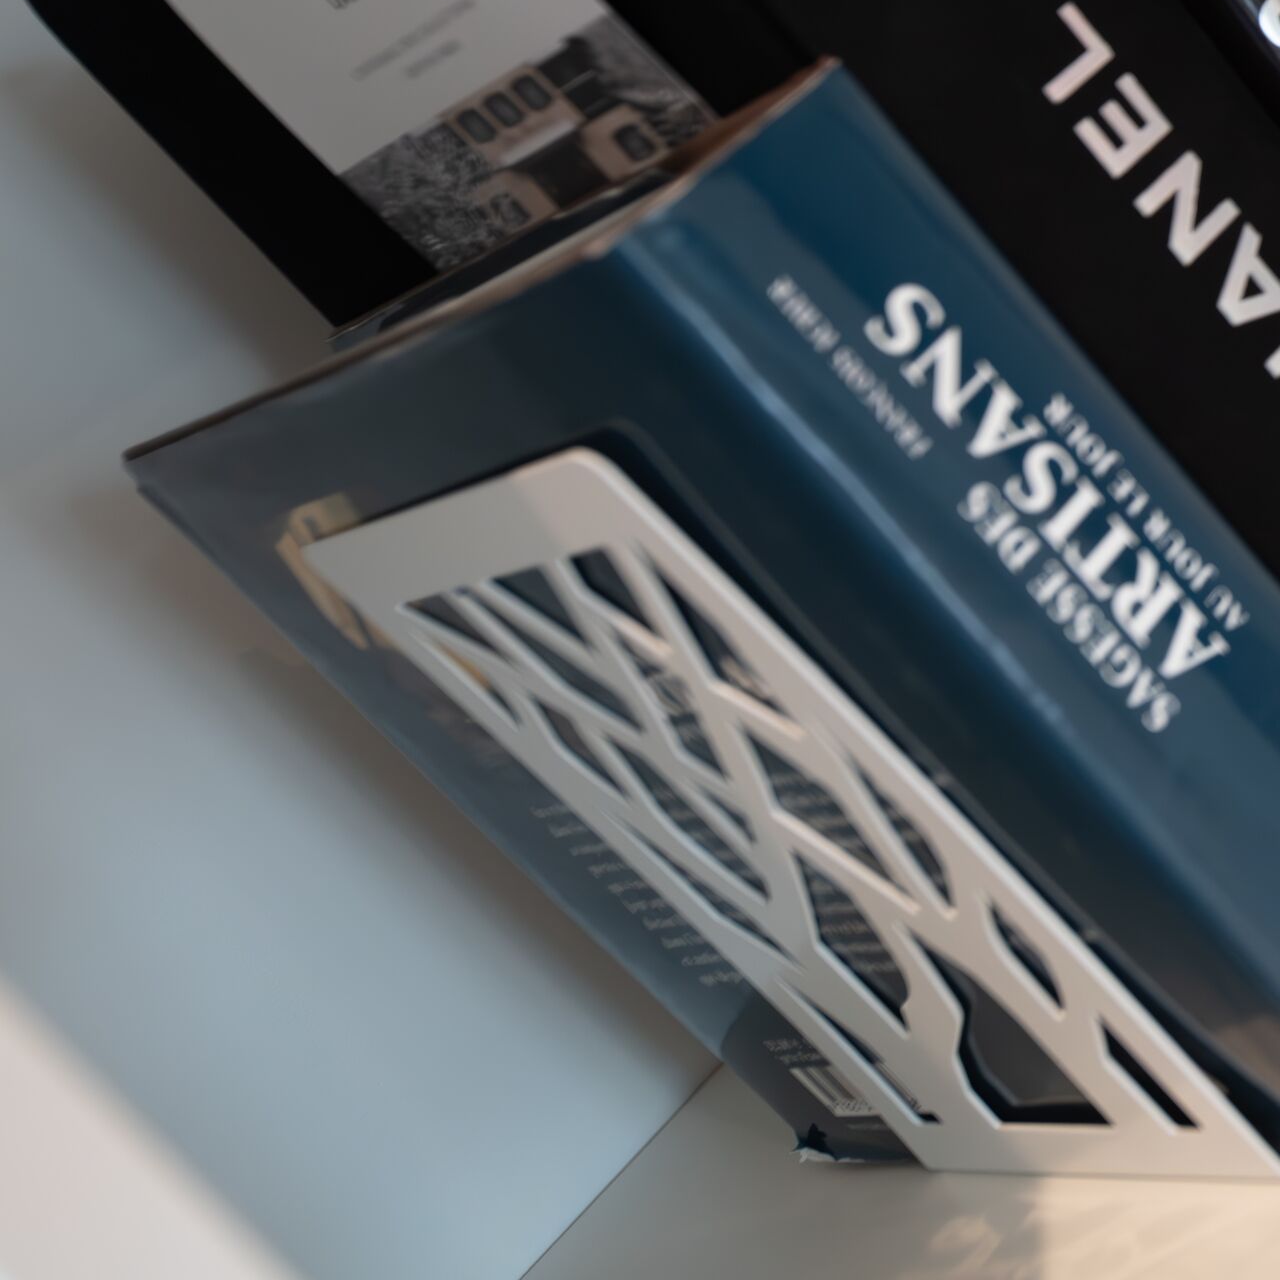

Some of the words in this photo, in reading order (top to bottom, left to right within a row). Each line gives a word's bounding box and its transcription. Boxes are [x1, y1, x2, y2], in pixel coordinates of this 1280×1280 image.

[1040, 391, 1122, 479] JOUR
[861, 280, 1230, 682] ARTISANS
[1109, 472, 1152, 519] LE
[958, 479, 1053, 574] DES
[1140, 508, 1219, 593] JOUR
[1026, 559, 1183, 735] SAGESSE
[1204, 585, 1250, 633] AU
